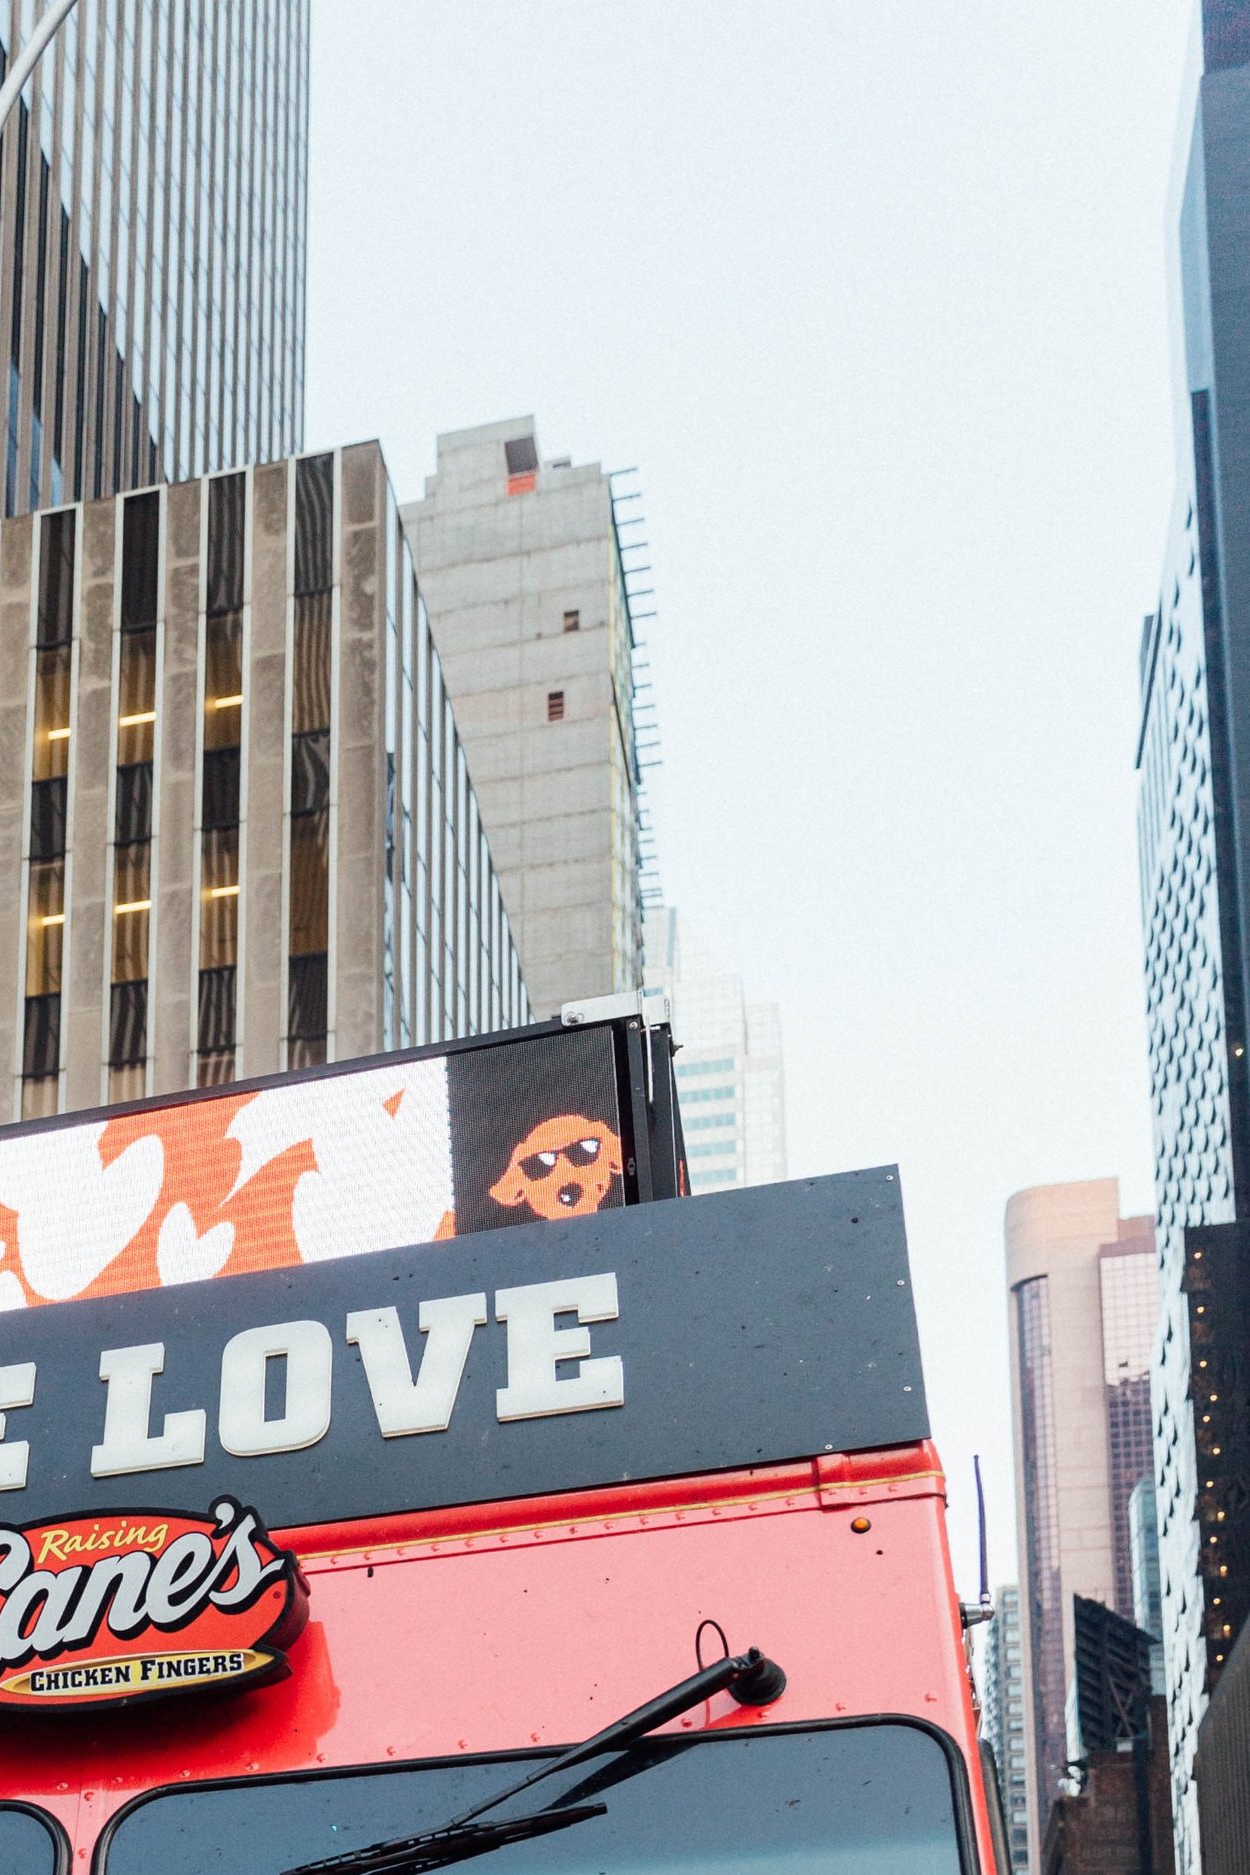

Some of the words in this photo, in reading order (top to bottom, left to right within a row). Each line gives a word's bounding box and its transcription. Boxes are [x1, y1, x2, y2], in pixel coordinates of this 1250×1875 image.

[90, 1272, 625, 1478] LOVE
[37, 1520, 169, 1564] Raising
[30, 1663, 131, 1692] CHICKEN
[140, 1653, 243, 1682] FINGERS
